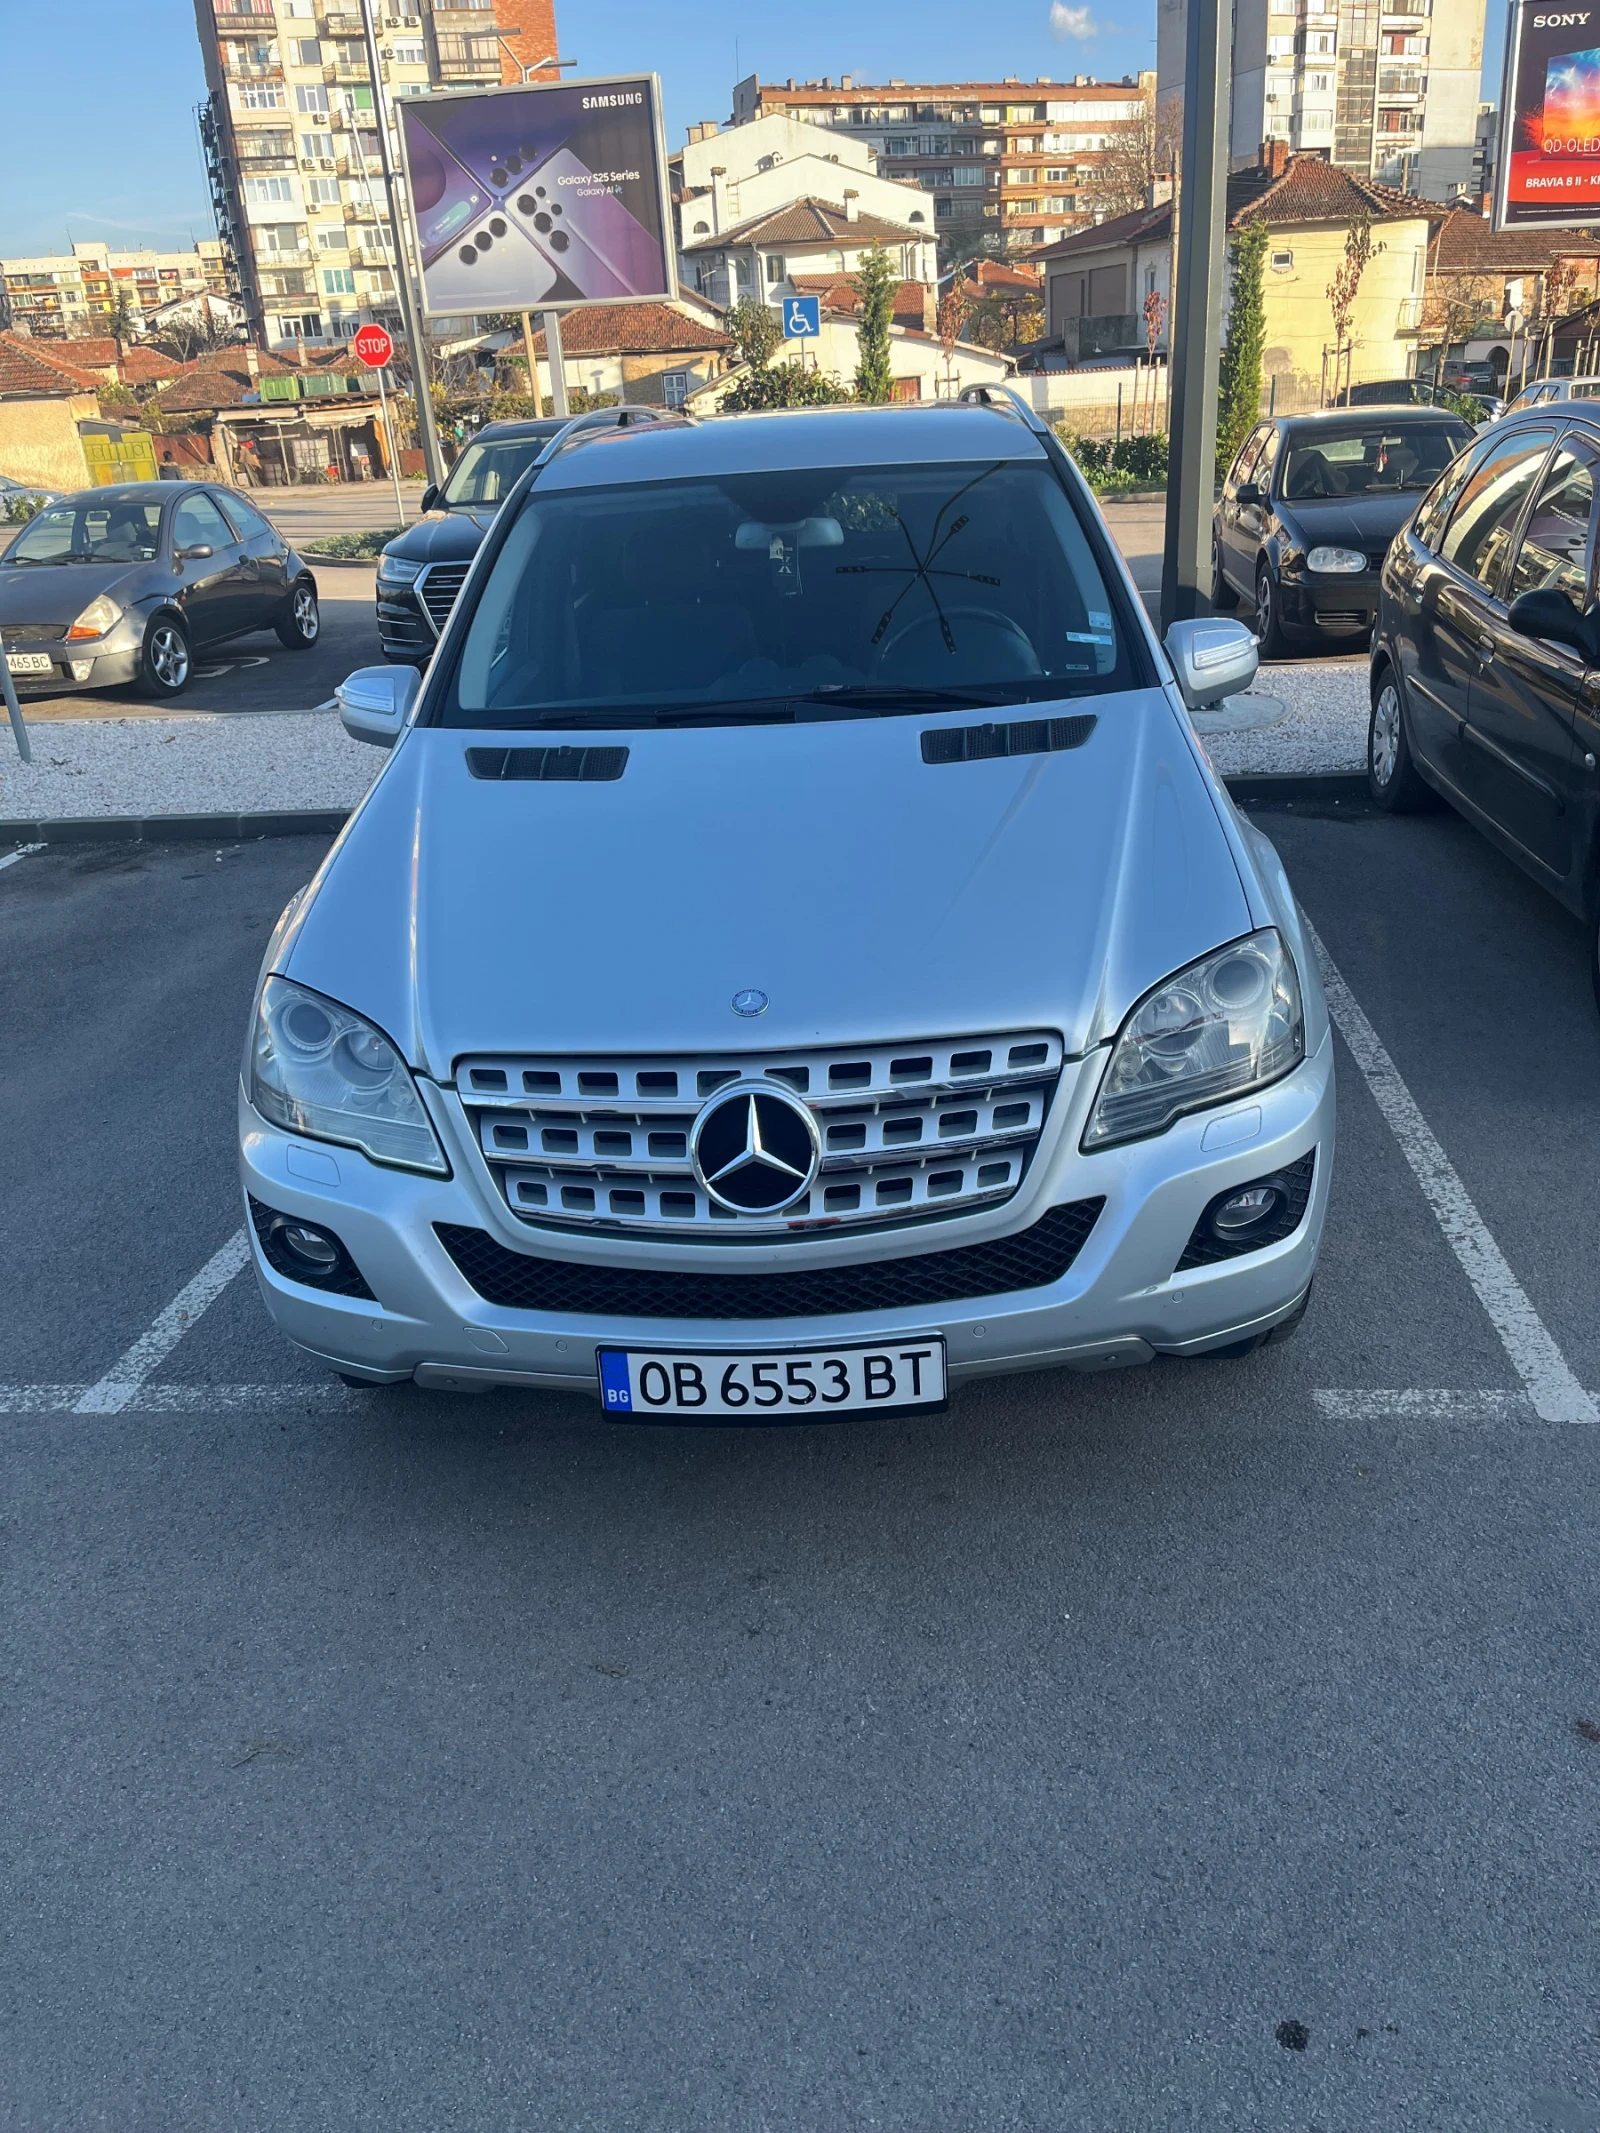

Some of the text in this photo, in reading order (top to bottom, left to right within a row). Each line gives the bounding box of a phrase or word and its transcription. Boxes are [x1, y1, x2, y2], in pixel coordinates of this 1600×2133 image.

[1533, 12, 1591, 28] SONY
[582, 92, 643, 109] SAMSUNG
[1543, 137, 1600, 154] QD-OLED
[557, 169, 640, 186] Galaxy S25 Series
[1525, 176, 1564, 189] BRAVIA
[1565, 176, 1573, 187] 8
[576, 185, 614, 197] Galaxy AI
[358, 338, 388, 354] STOP
[8, 656, 49, 669] 465 BC
[639, 1350, 932, 1407] OB 6553 BT
[607, 1388, 629, 1403] BG
